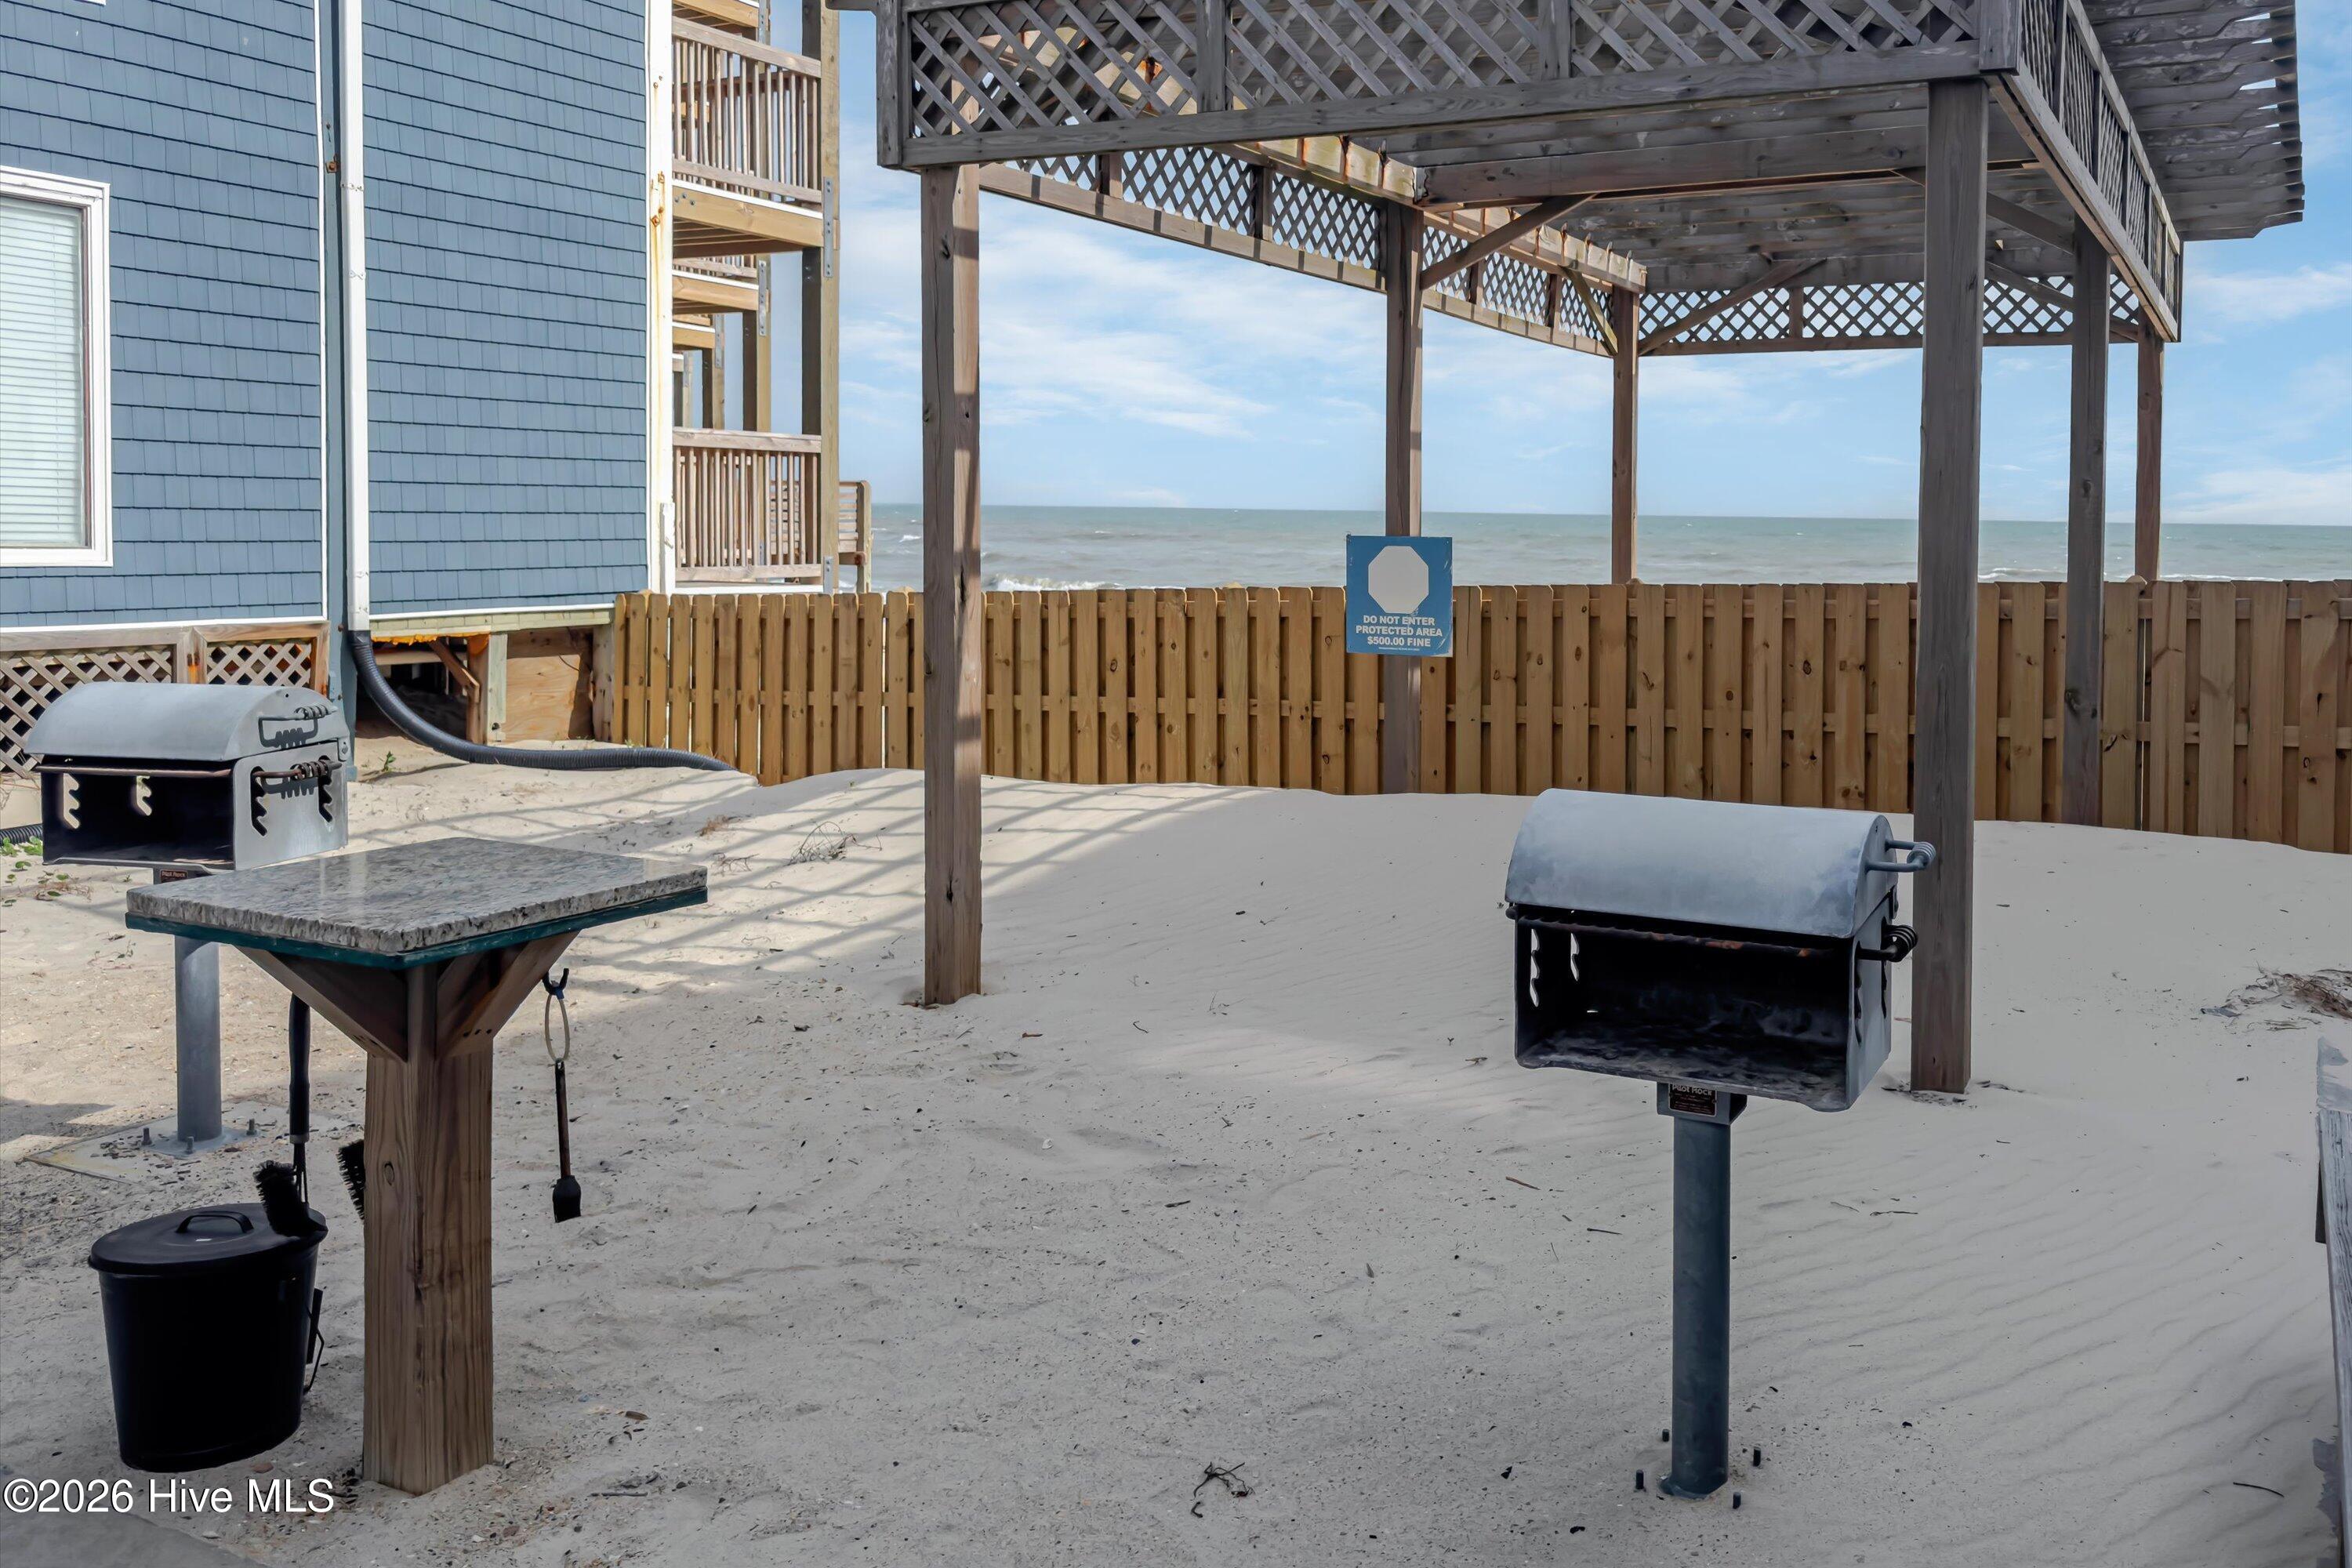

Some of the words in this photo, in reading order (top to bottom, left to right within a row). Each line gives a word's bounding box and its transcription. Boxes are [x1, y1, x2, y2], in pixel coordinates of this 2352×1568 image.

[1363, 615, 1377, 624] DO
[1379, 615, 1399, 625] NOT
[1402, 616, 1435, 626] ENTER
[1356, 626, 1414, 636] PROTECTED
[1415, 627, 1443, 637] AREA
[1367, 636, 1405, 646] $500.00
[1407, 638, 1431, 647] FINE
